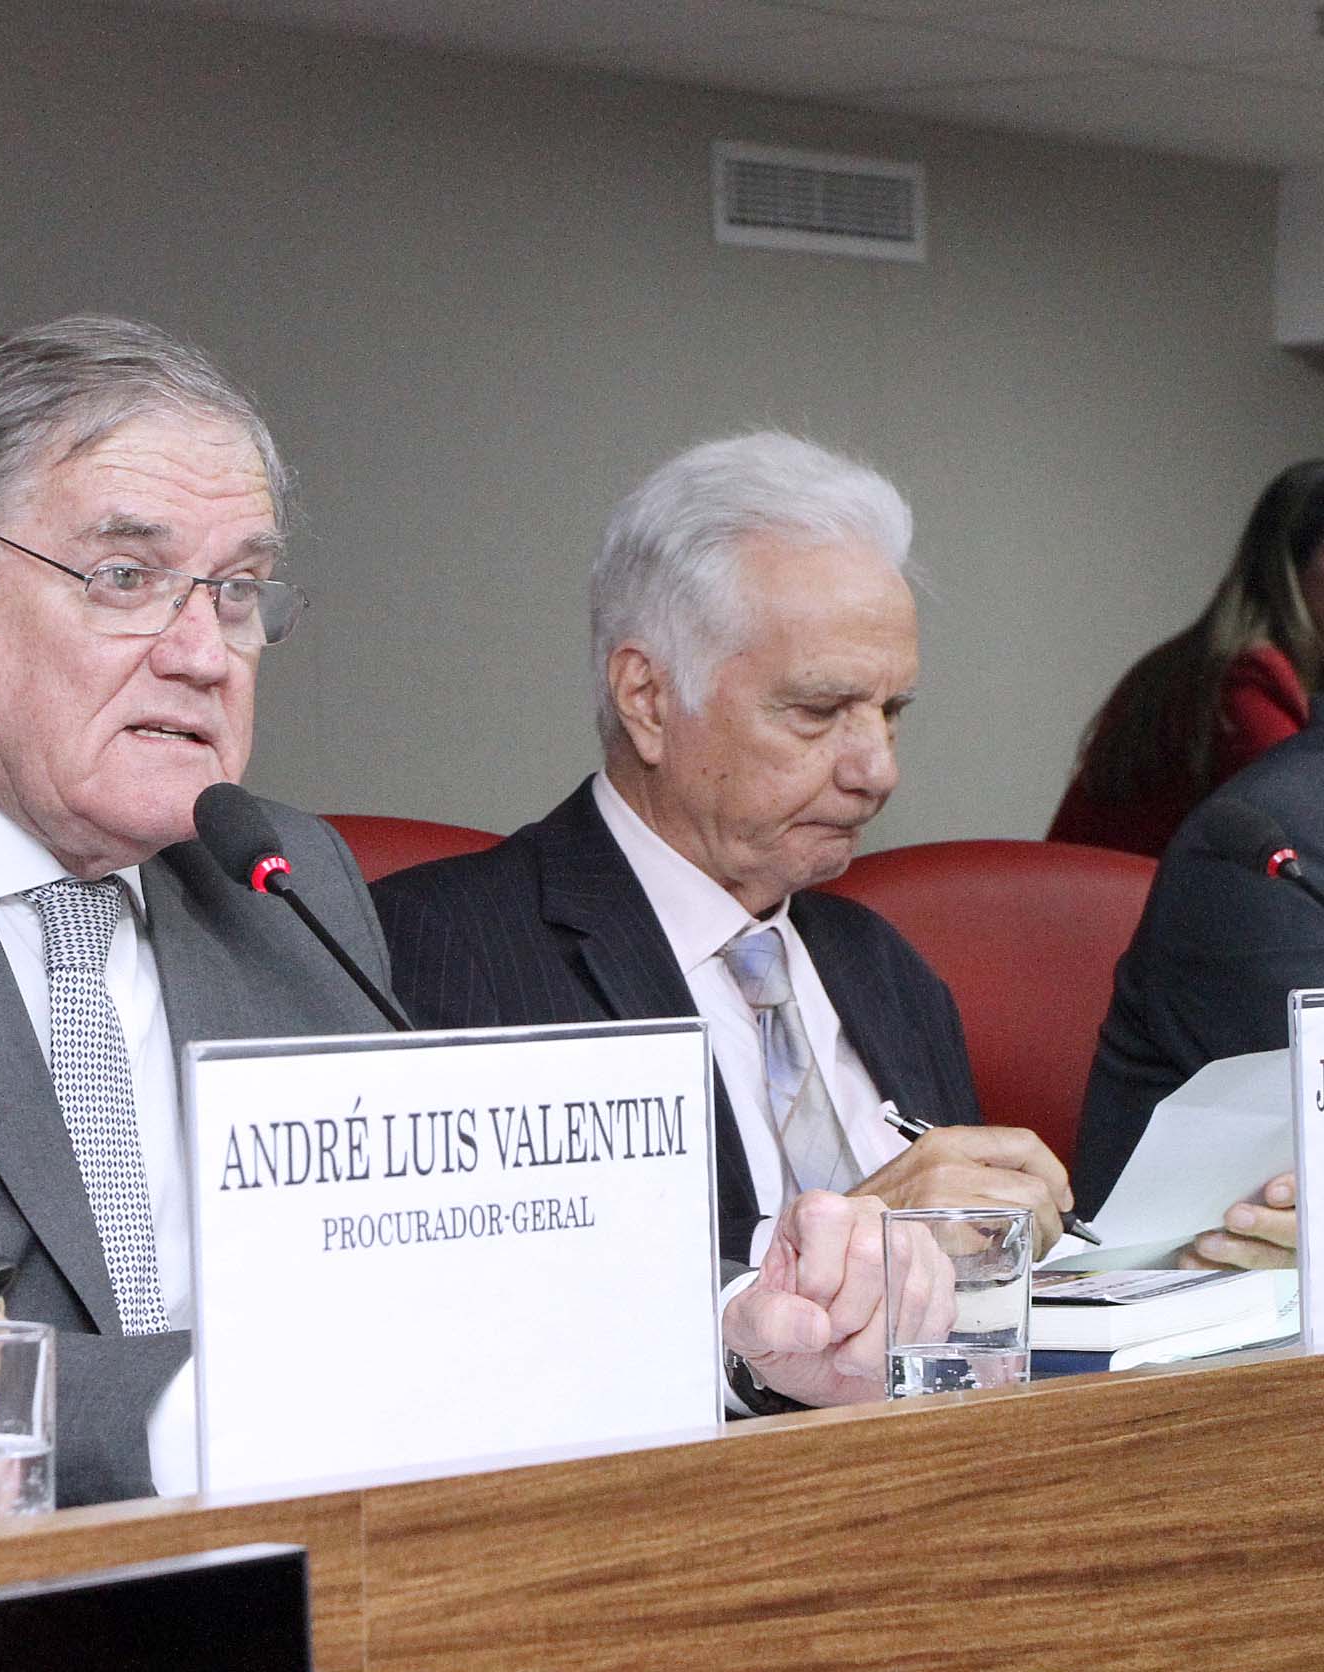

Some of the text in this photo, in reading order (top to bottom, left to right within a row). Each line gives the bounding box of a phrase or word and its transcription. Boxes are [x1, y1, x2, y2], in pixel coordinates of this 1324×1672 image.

[219, 1095, 688, 1191] ANDRÉ LUIS VALENTIM
[322, 1195, 595, 1252] PROCURADOR-GERAL
